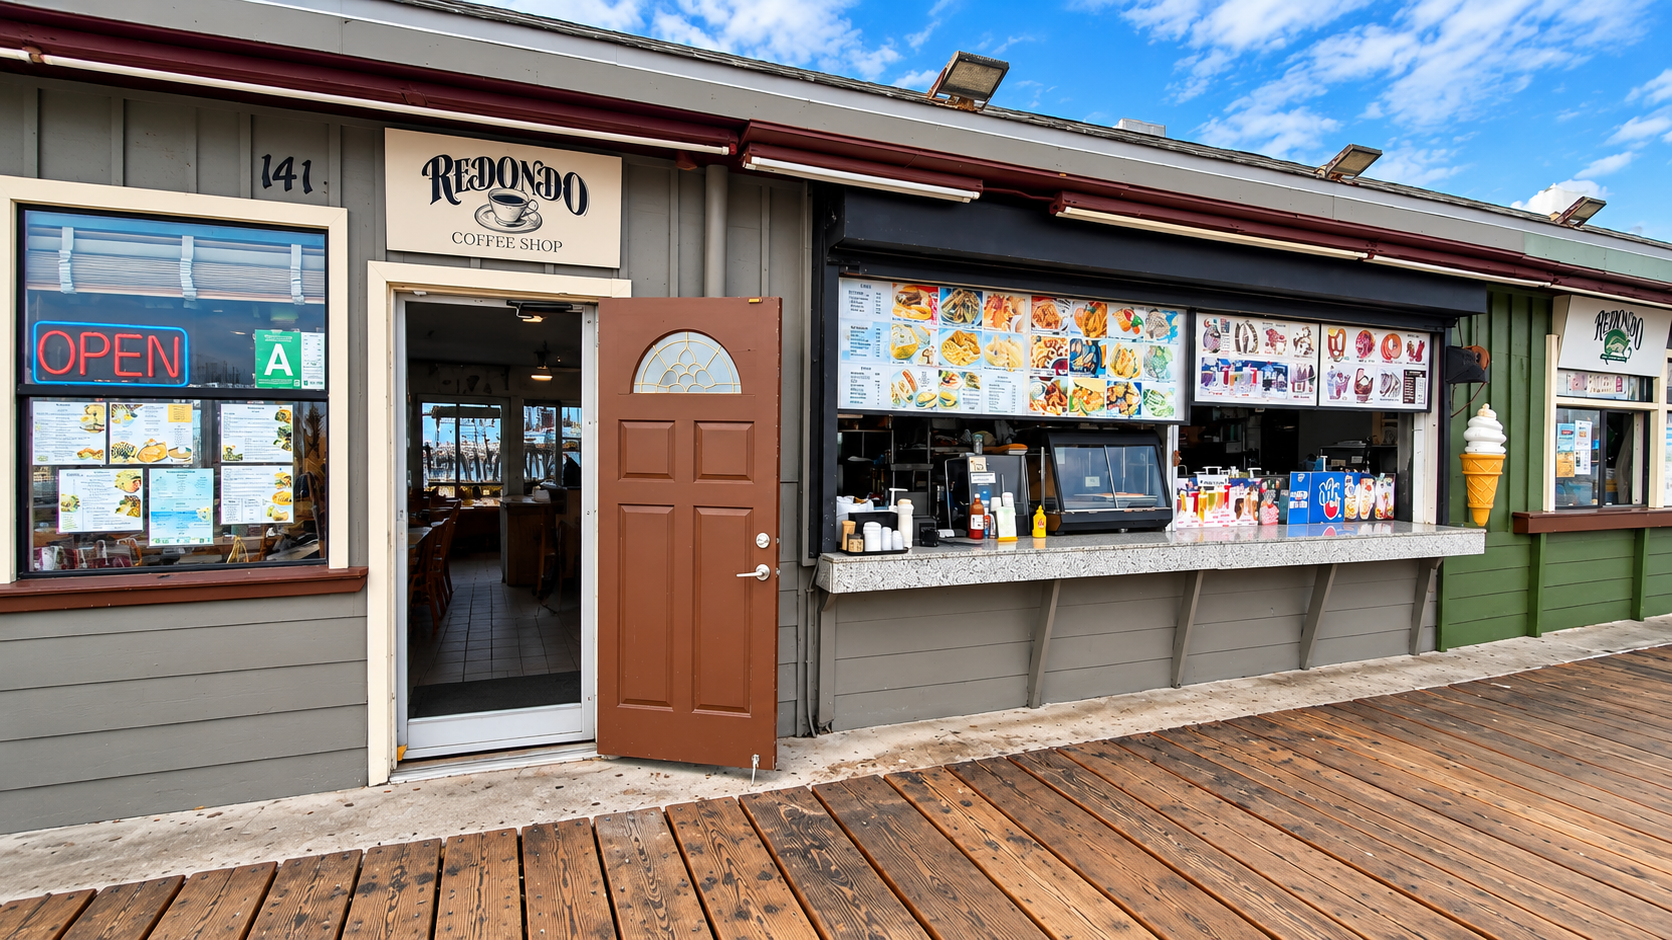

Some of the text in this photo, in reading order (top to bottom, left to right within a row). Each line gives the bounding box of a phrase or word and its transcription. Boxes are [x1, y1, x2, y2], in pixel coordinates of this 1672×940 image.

[261, 154, 313, 194] 141
[421, 154, 590, 217] REDONDO
[451, 231, 563, 253] COFFEE SHOP
[37, 330, 180, 378] OPEN
[264, 343, 294, 376] A
